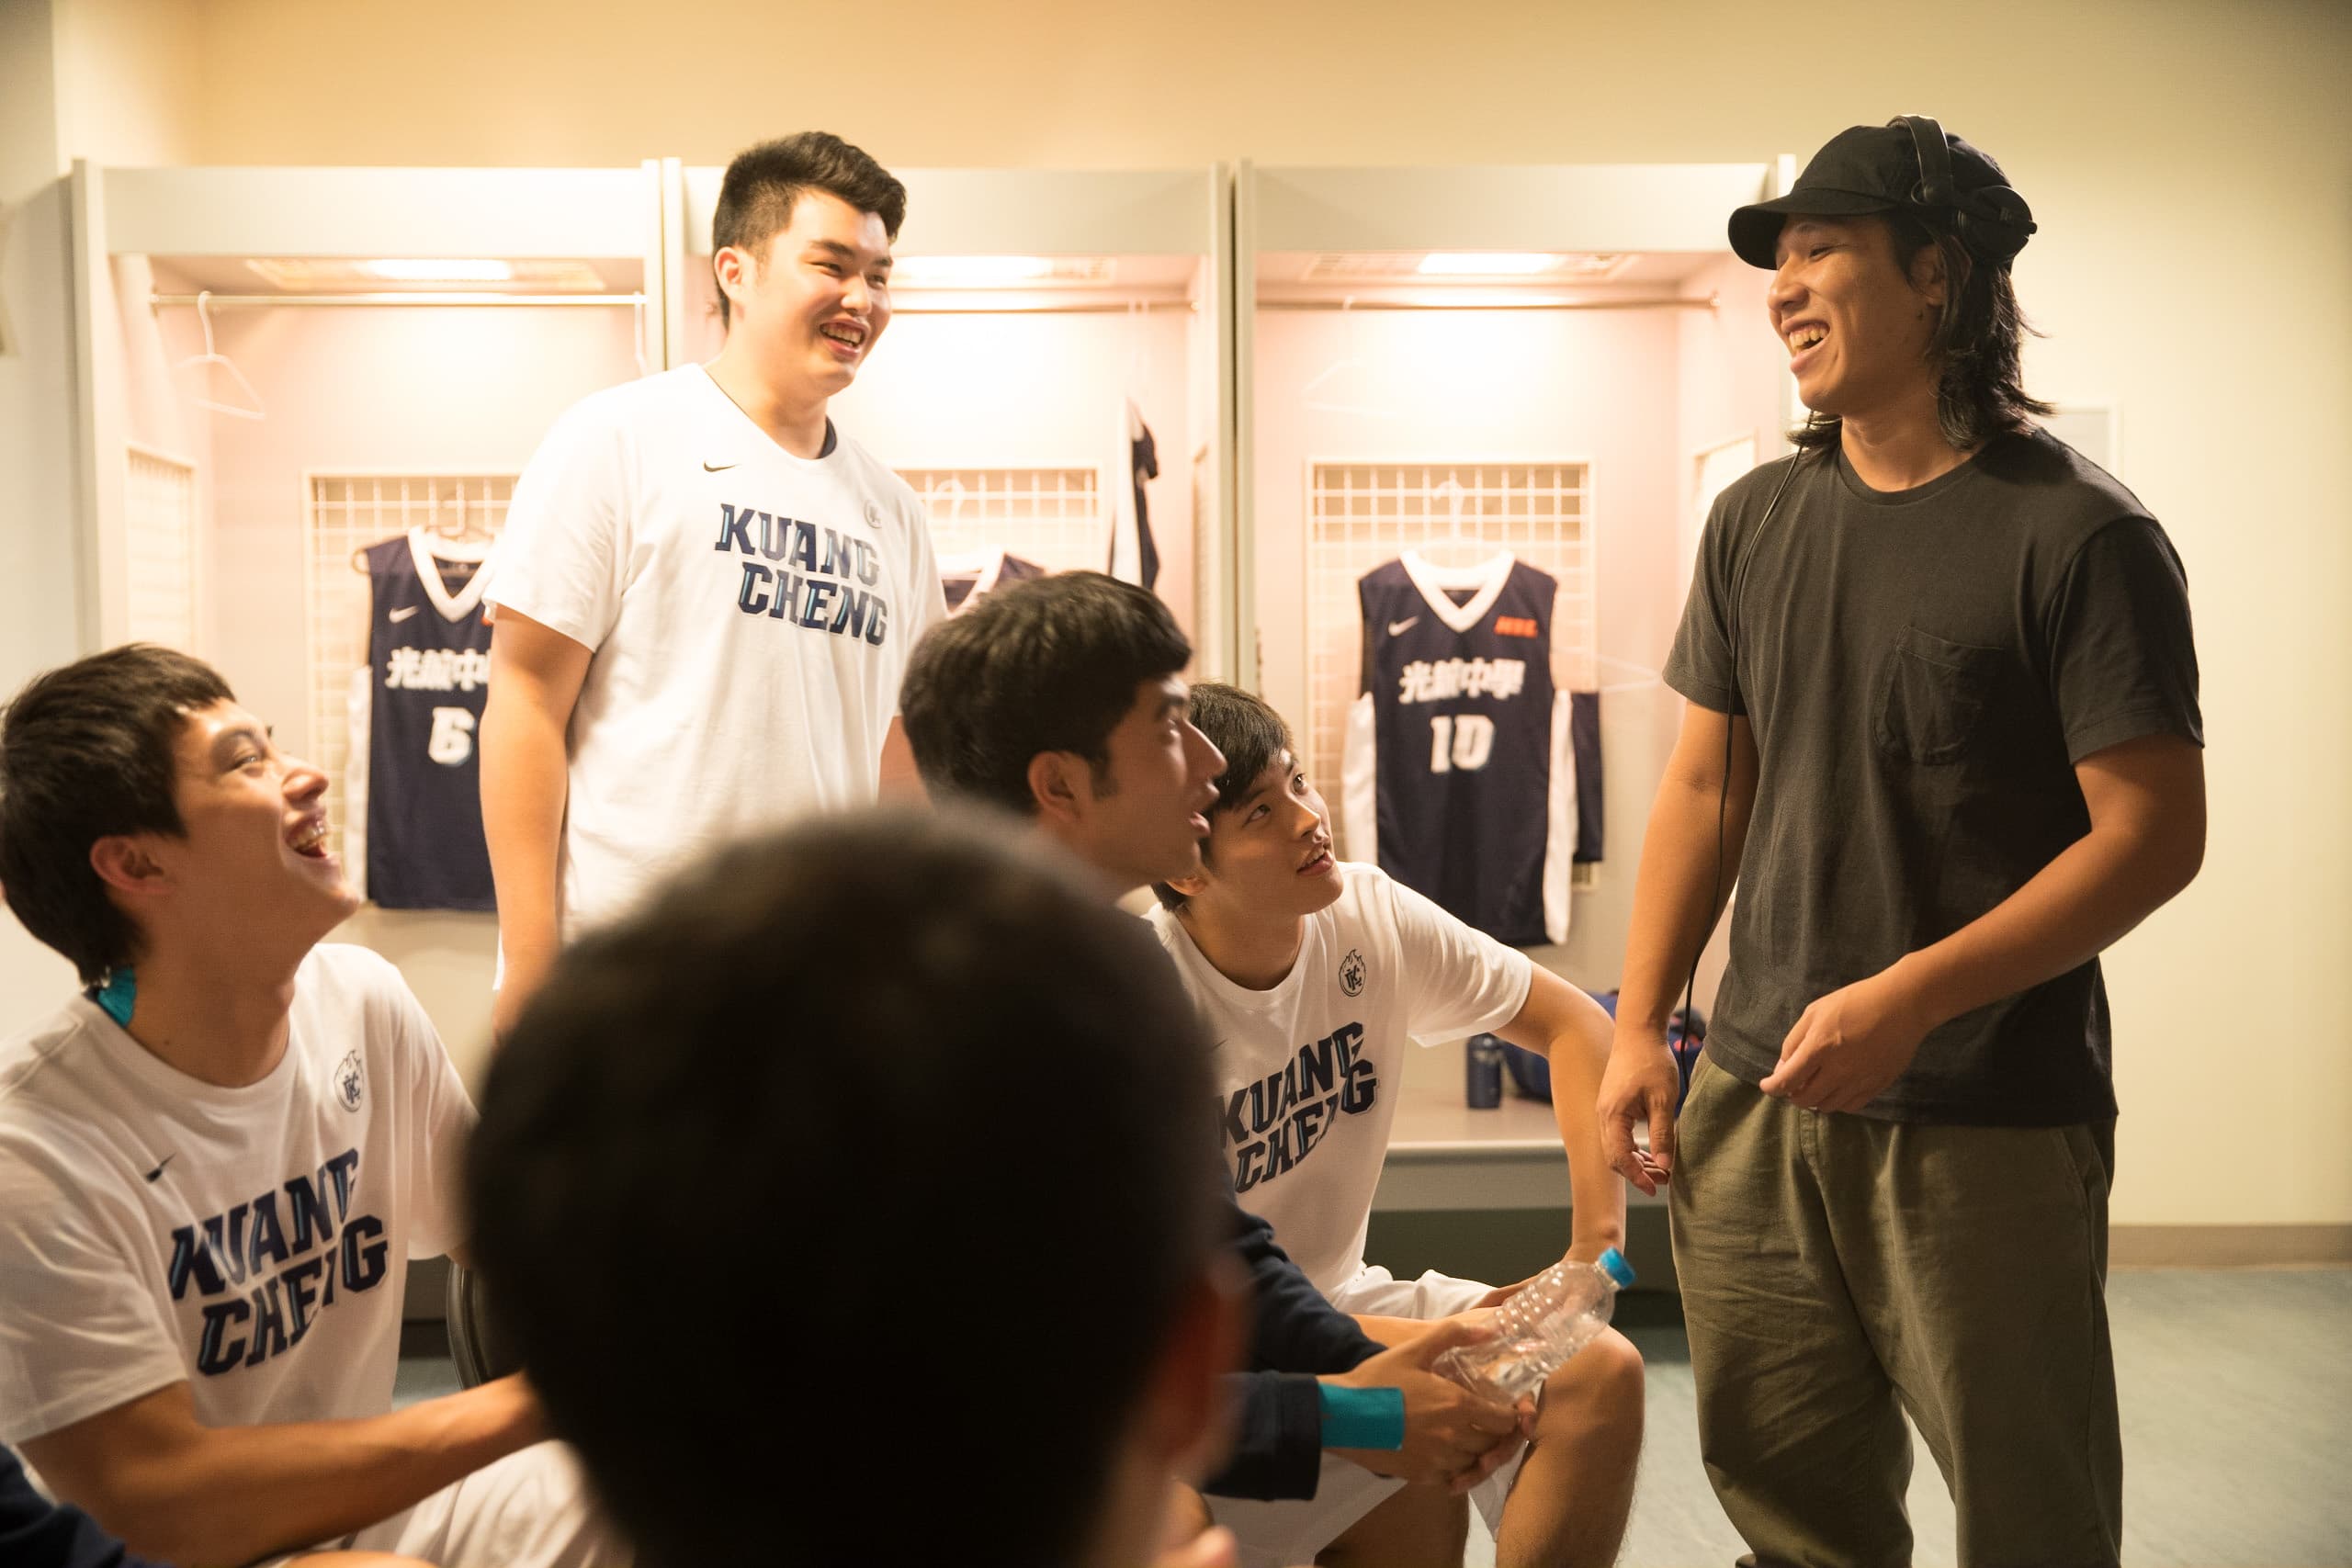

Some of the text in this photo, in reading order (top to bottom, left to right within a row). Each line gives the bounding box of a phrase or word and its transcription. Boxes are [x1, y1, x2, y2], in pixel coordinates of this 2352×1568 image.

[715, 503, 879, 587] KUANG
[738, 561, 888, 647] CHENG
[384, 646, 491, 692] 光中
[428, 706, 475, 766] 6
[1430, 714, 1495, 773] 10
